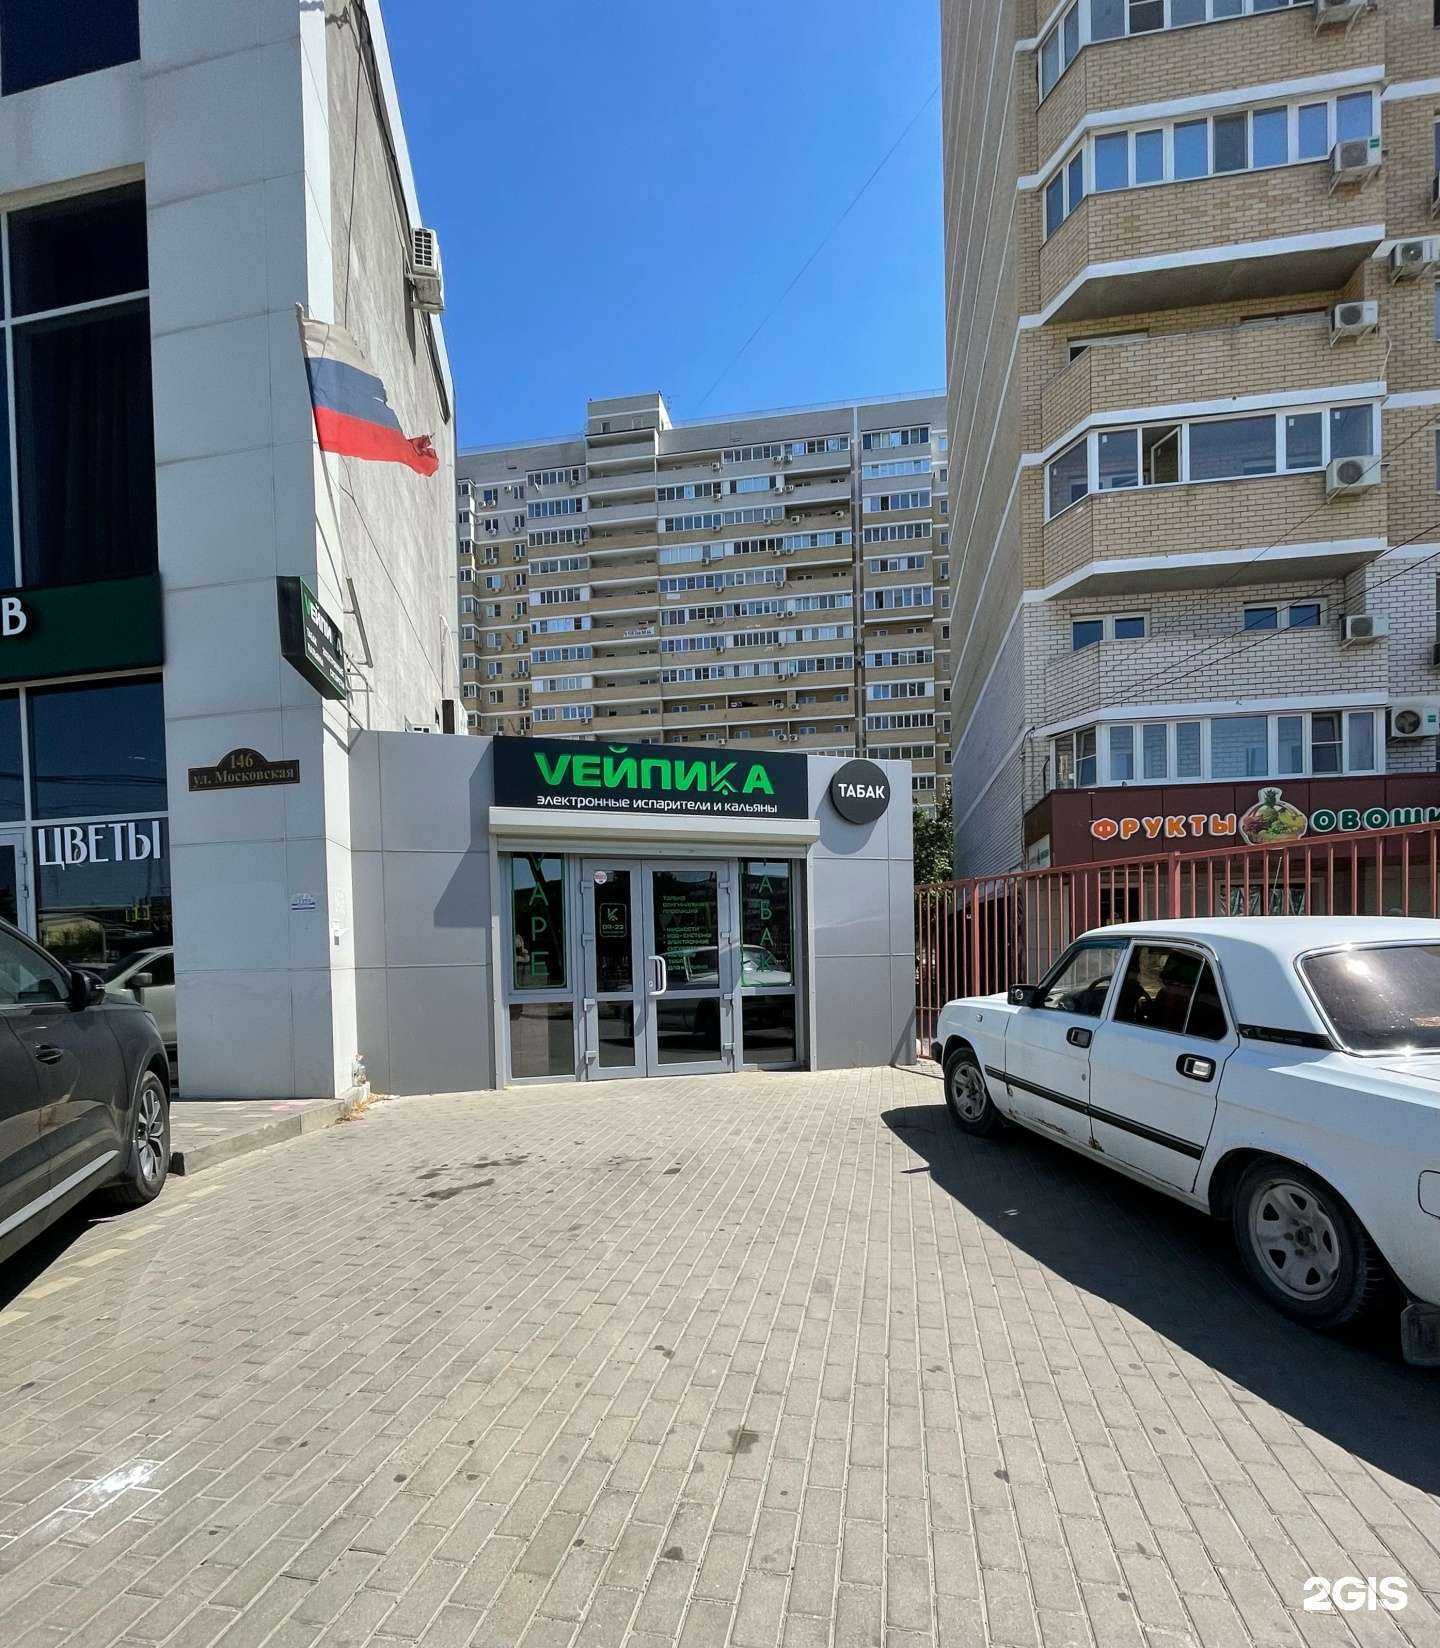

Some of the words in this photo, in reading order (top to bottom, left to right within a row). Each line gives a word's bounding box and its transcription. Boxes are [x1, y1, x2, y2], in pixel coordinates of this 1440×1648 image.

[1, 596, 27, 636] В
[230, 754, 254, 768] 146
[192, 775, 211, 788] ул.
[215, 767, 294, 784] Московская
[837, 783, 886, 799] ТАБАК
[536, 795, 630, 809] электронные
[633, 798, 711, 812] испарители
[713, 802, 722, 812] и
[724, 803, 778, 814] кальяны
[1091, 813, 1238, 841] ФРУКТЫ
[37, 820, 161, 871] ЦВЕТЫ
